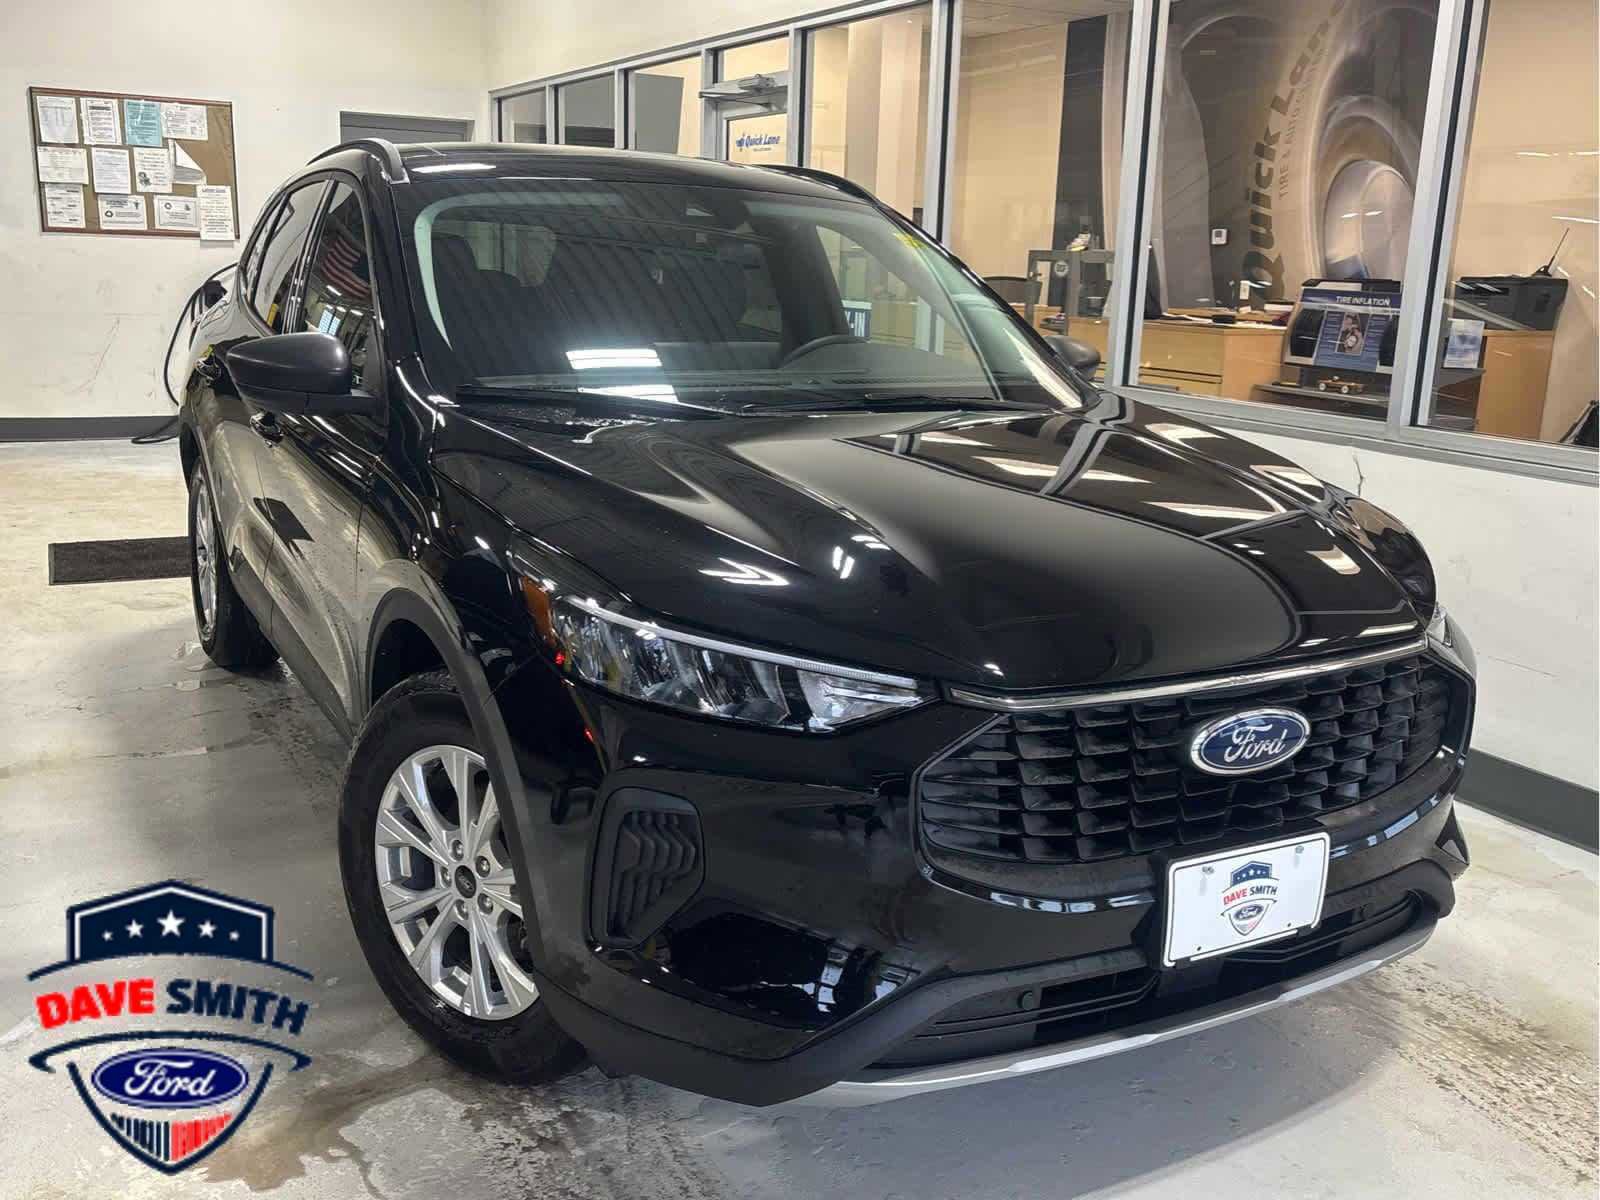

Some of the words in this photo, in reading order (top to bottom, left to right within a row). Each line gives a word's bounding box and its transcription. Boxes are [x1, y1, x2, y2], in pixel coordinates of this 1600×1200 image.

[744, 135, 763, 148] Quick
[763, 134, 781, 145] Lane
[1279, 164, 1289, 200] TIRE
[1242, 125, 1285, 300] Quick
[1336, 296, 1353, 304] TIRE
[1352, 296, 1390, 306] INFLATION
[1223, 723, 1288, 763] Ford
[1223, 888, 1248, 906] DAVE
[1249, 885, 1278, 897] SMITH
